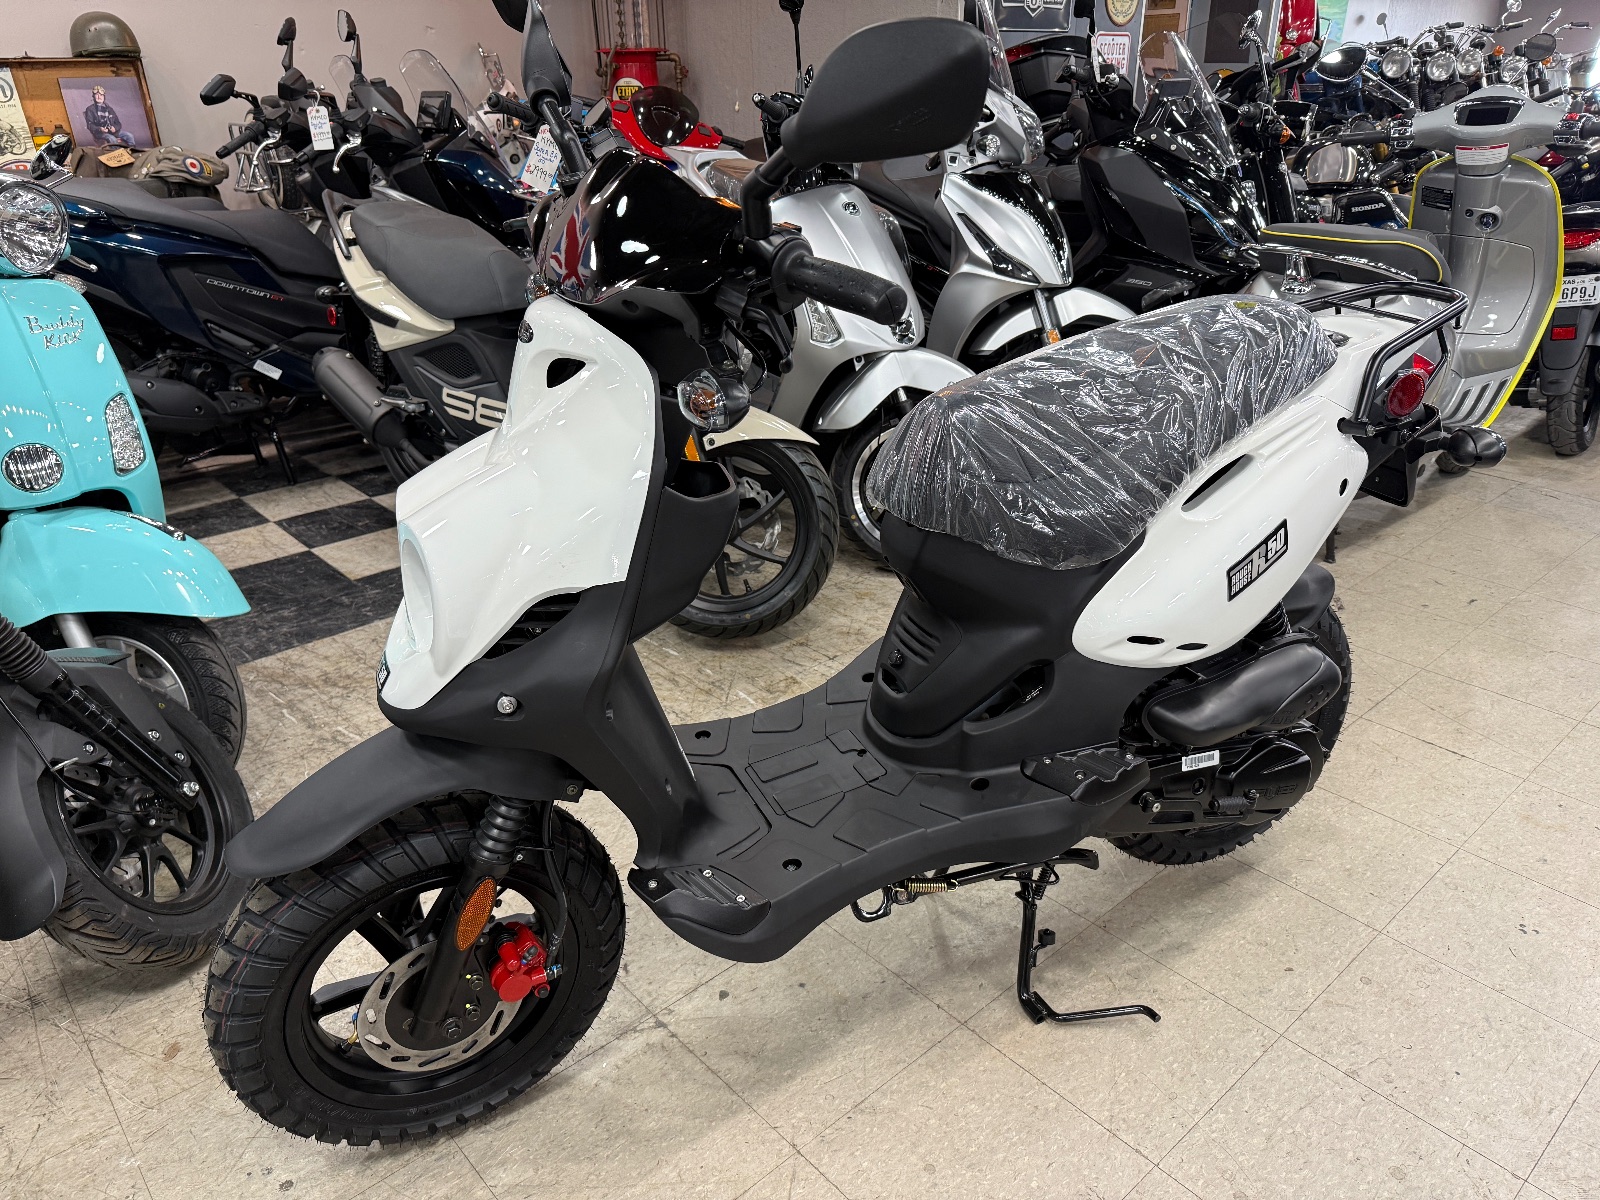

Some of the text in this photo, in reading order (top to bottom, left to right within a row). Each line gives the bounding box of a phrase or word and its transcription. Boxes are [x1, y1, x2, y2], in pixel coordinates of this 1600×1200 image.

[1100, 42, 1126, 56] SCOOTER
[617, 86, 639, 98] ETHY
[1351, 202, 1387, 213] HONDA
[206, 278, 270, 299] DOWNTOWN
[23, 310, 84, 335] Buddy
[1231, 561, 1252, 587] ROUGH
[1231, 571, 1252, 596] HOUSE
